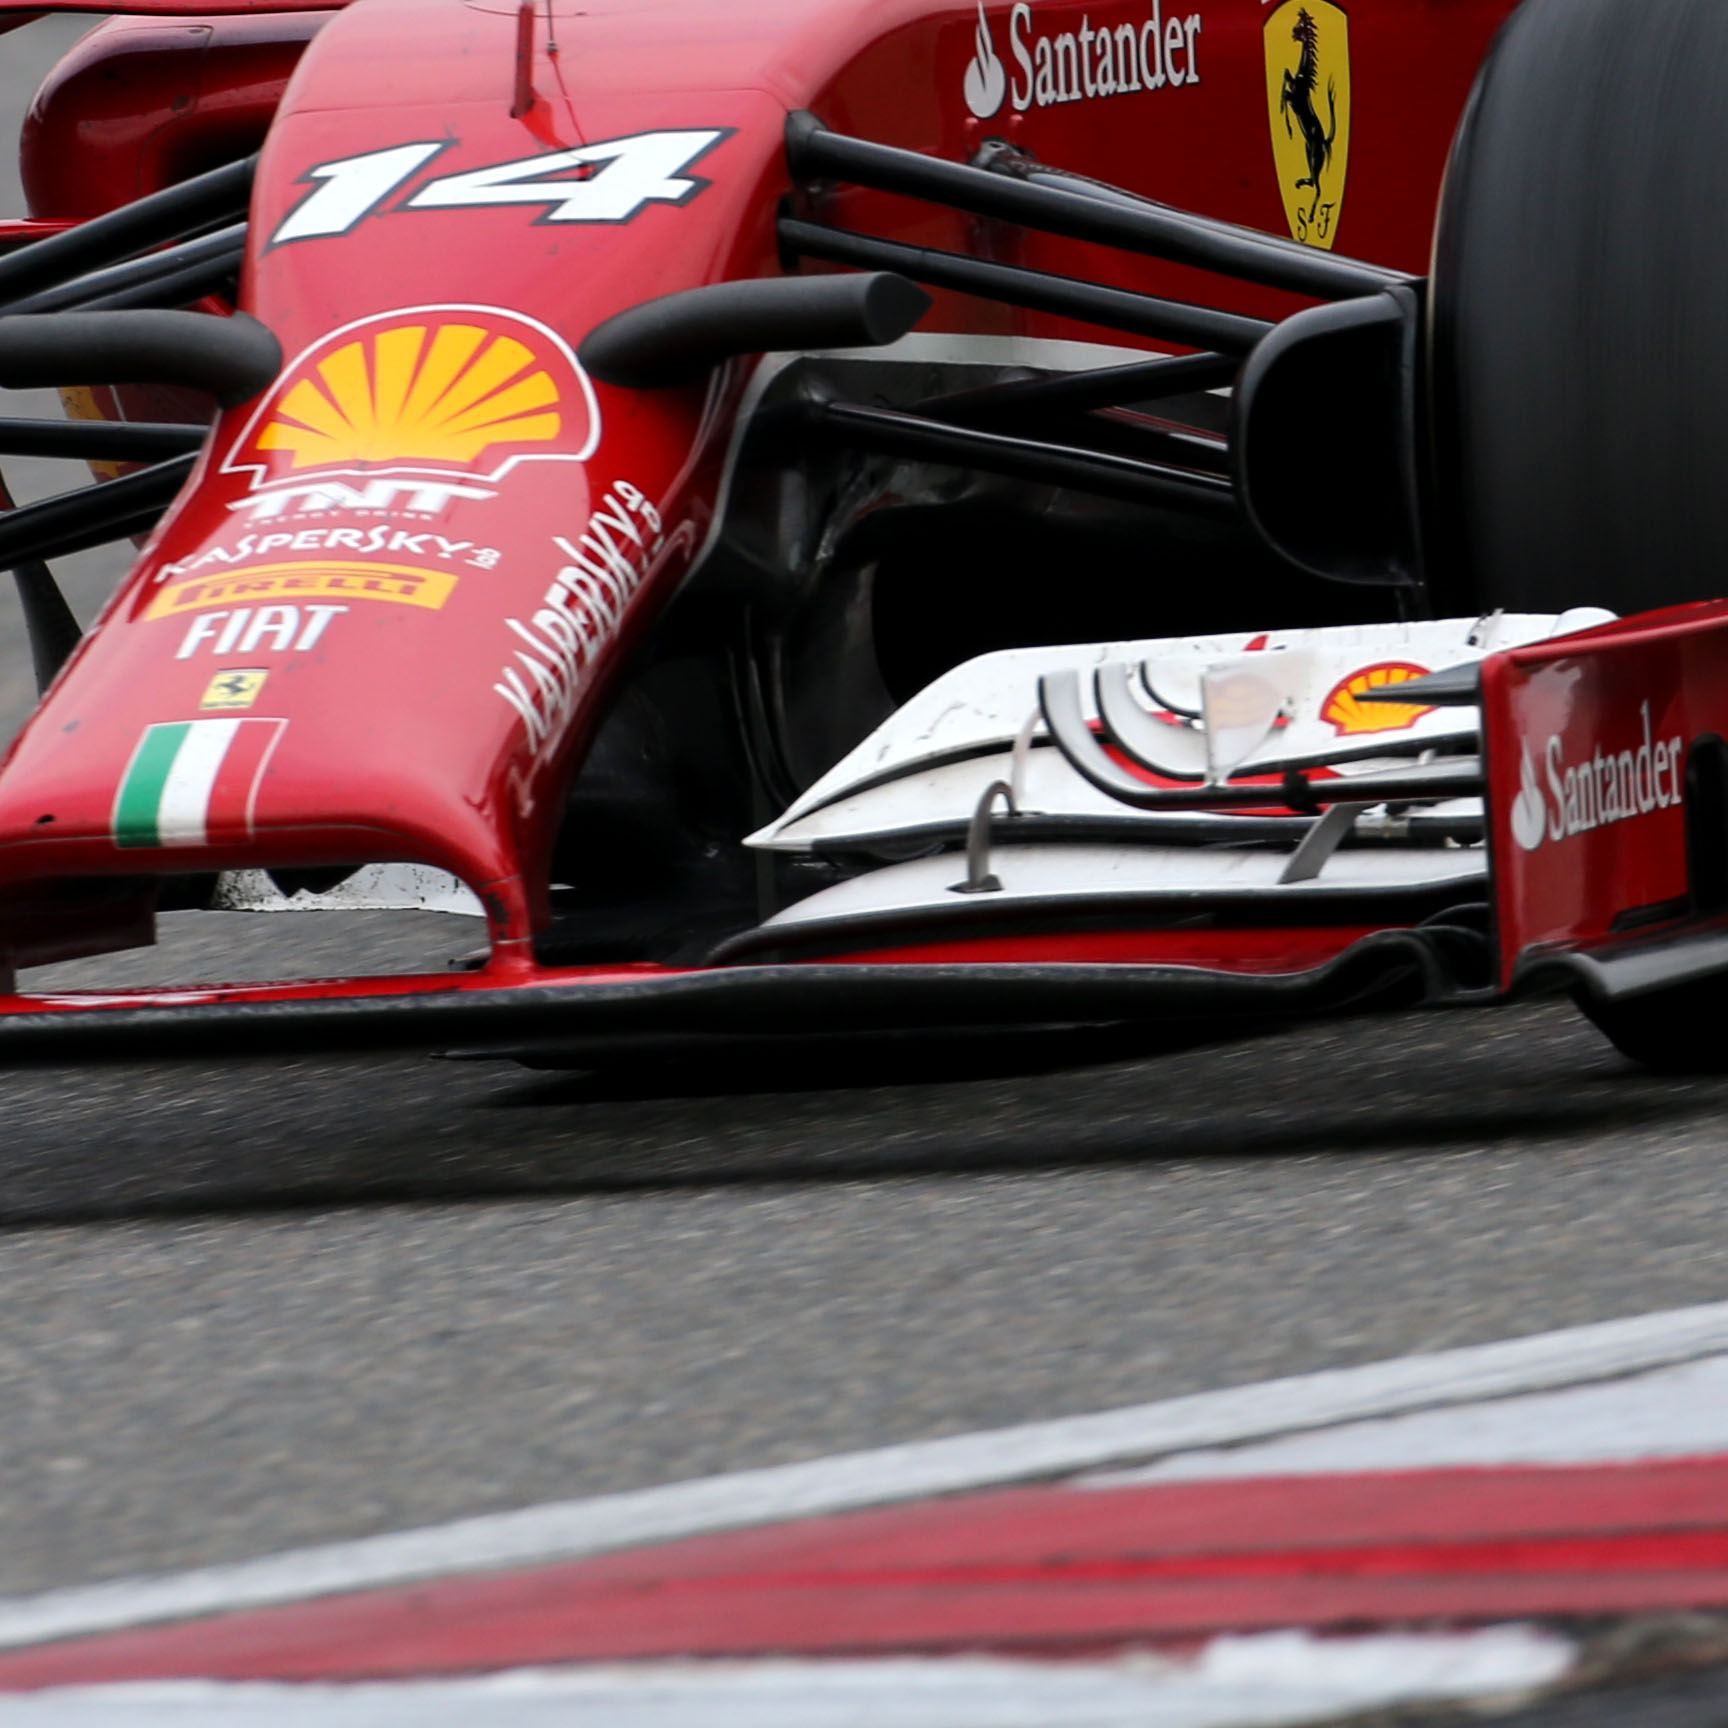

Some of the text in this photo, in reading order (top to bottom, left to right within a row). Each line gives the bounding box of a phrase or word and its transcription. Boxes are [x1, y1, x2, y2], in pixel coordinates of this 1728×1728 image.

[260, 126, 738, 255] 14
[225, 478, 499, 519] TNT
[153, 525, 474, 583] KASPERSKY
[173, 568, 427, 607] PIRELLI
[175, 604, 350, 660] FIAT
[1545, 699, 1683, 842] Santander
